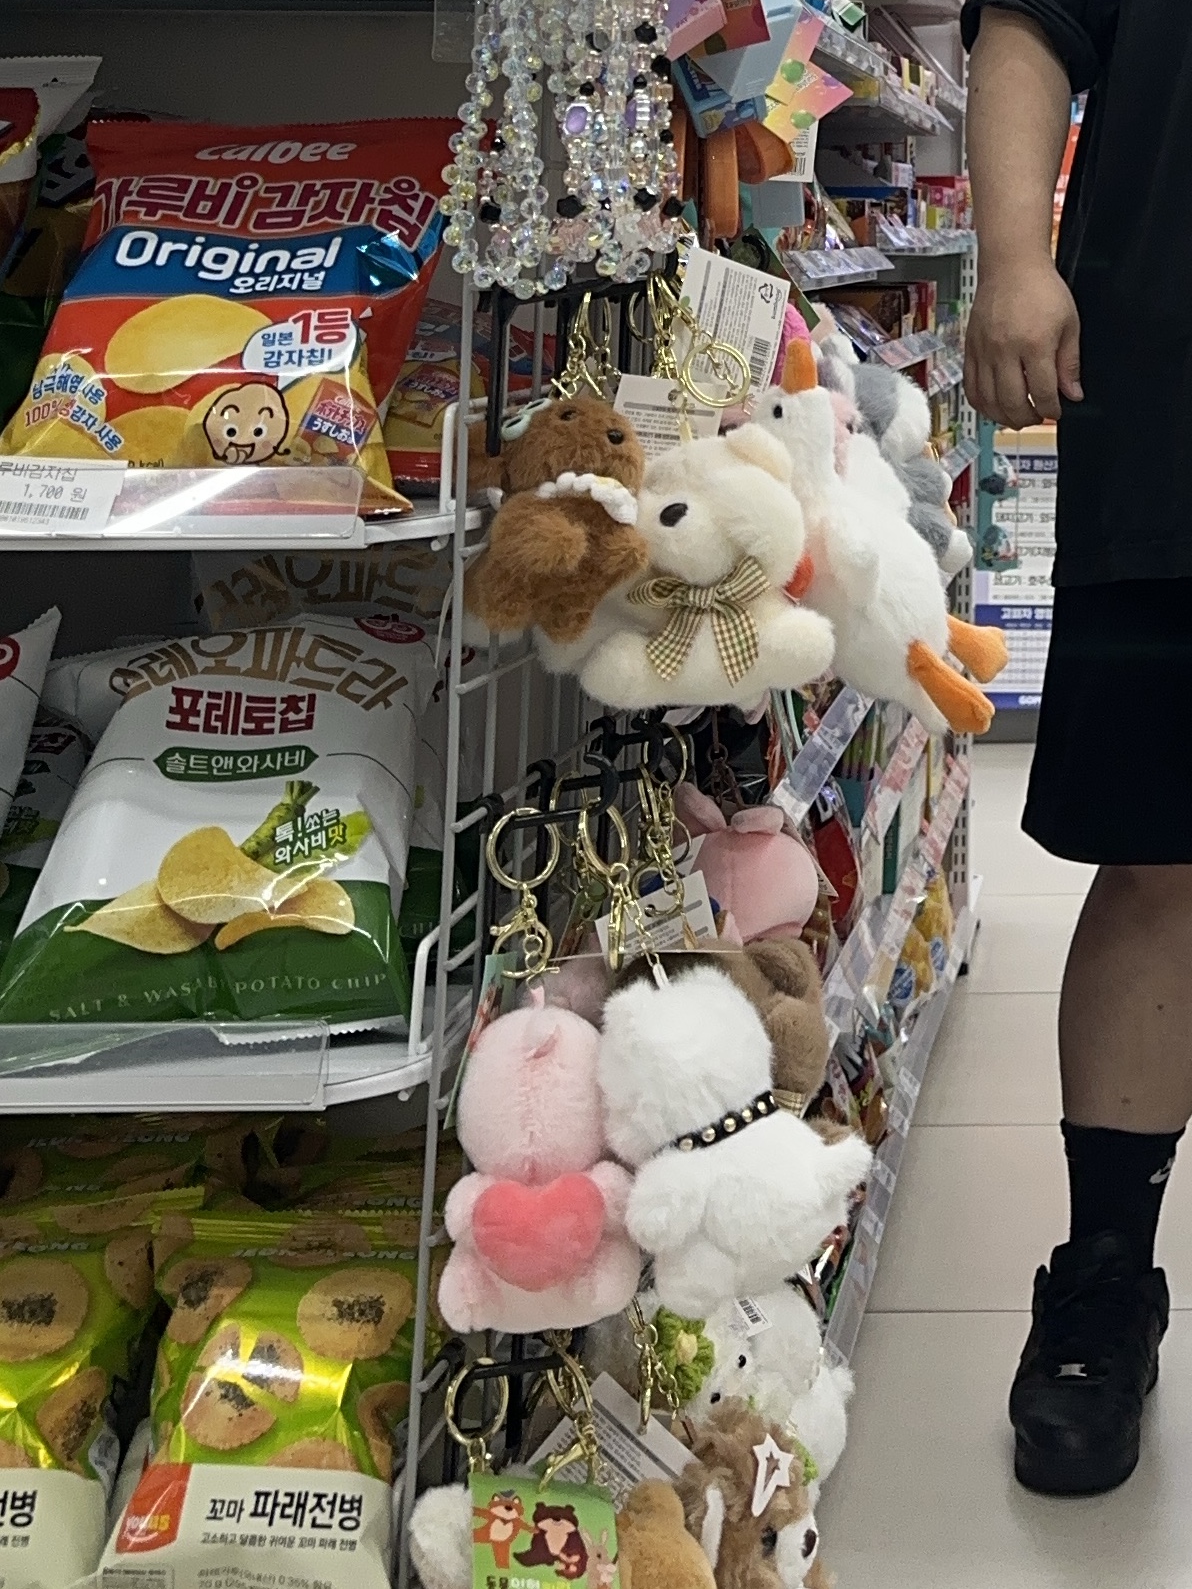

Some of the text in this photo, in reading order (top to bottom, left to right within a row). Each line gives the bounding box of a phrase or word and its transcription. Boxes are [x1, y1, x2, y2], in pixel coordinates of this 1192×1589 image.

[115, 230, 343, 281] Original
[229, 270, 326, 295] 오리지널
[261, 309, 351, 347] 일본 1등
[263, 347, 333, 369] 감자칩!
[95, 424, 123, 452] 사용
[23, 483, 88, 503] 1,700 원
[165, 685, 317, 737] 포테토칩
[166, 747, 306, 777] 솔트앤와사비
[274, 808, 341, 842] 톡! 쏘는
[274, 822, 348, 866] 와사비맛
[49, 998, 103, 1022] SALT
[235, 975, 322, 995] POTATO
[205, 1489, 364, 1532] 꼬마 파래전병
[200, 1532, 238, 1545] 고소하고
